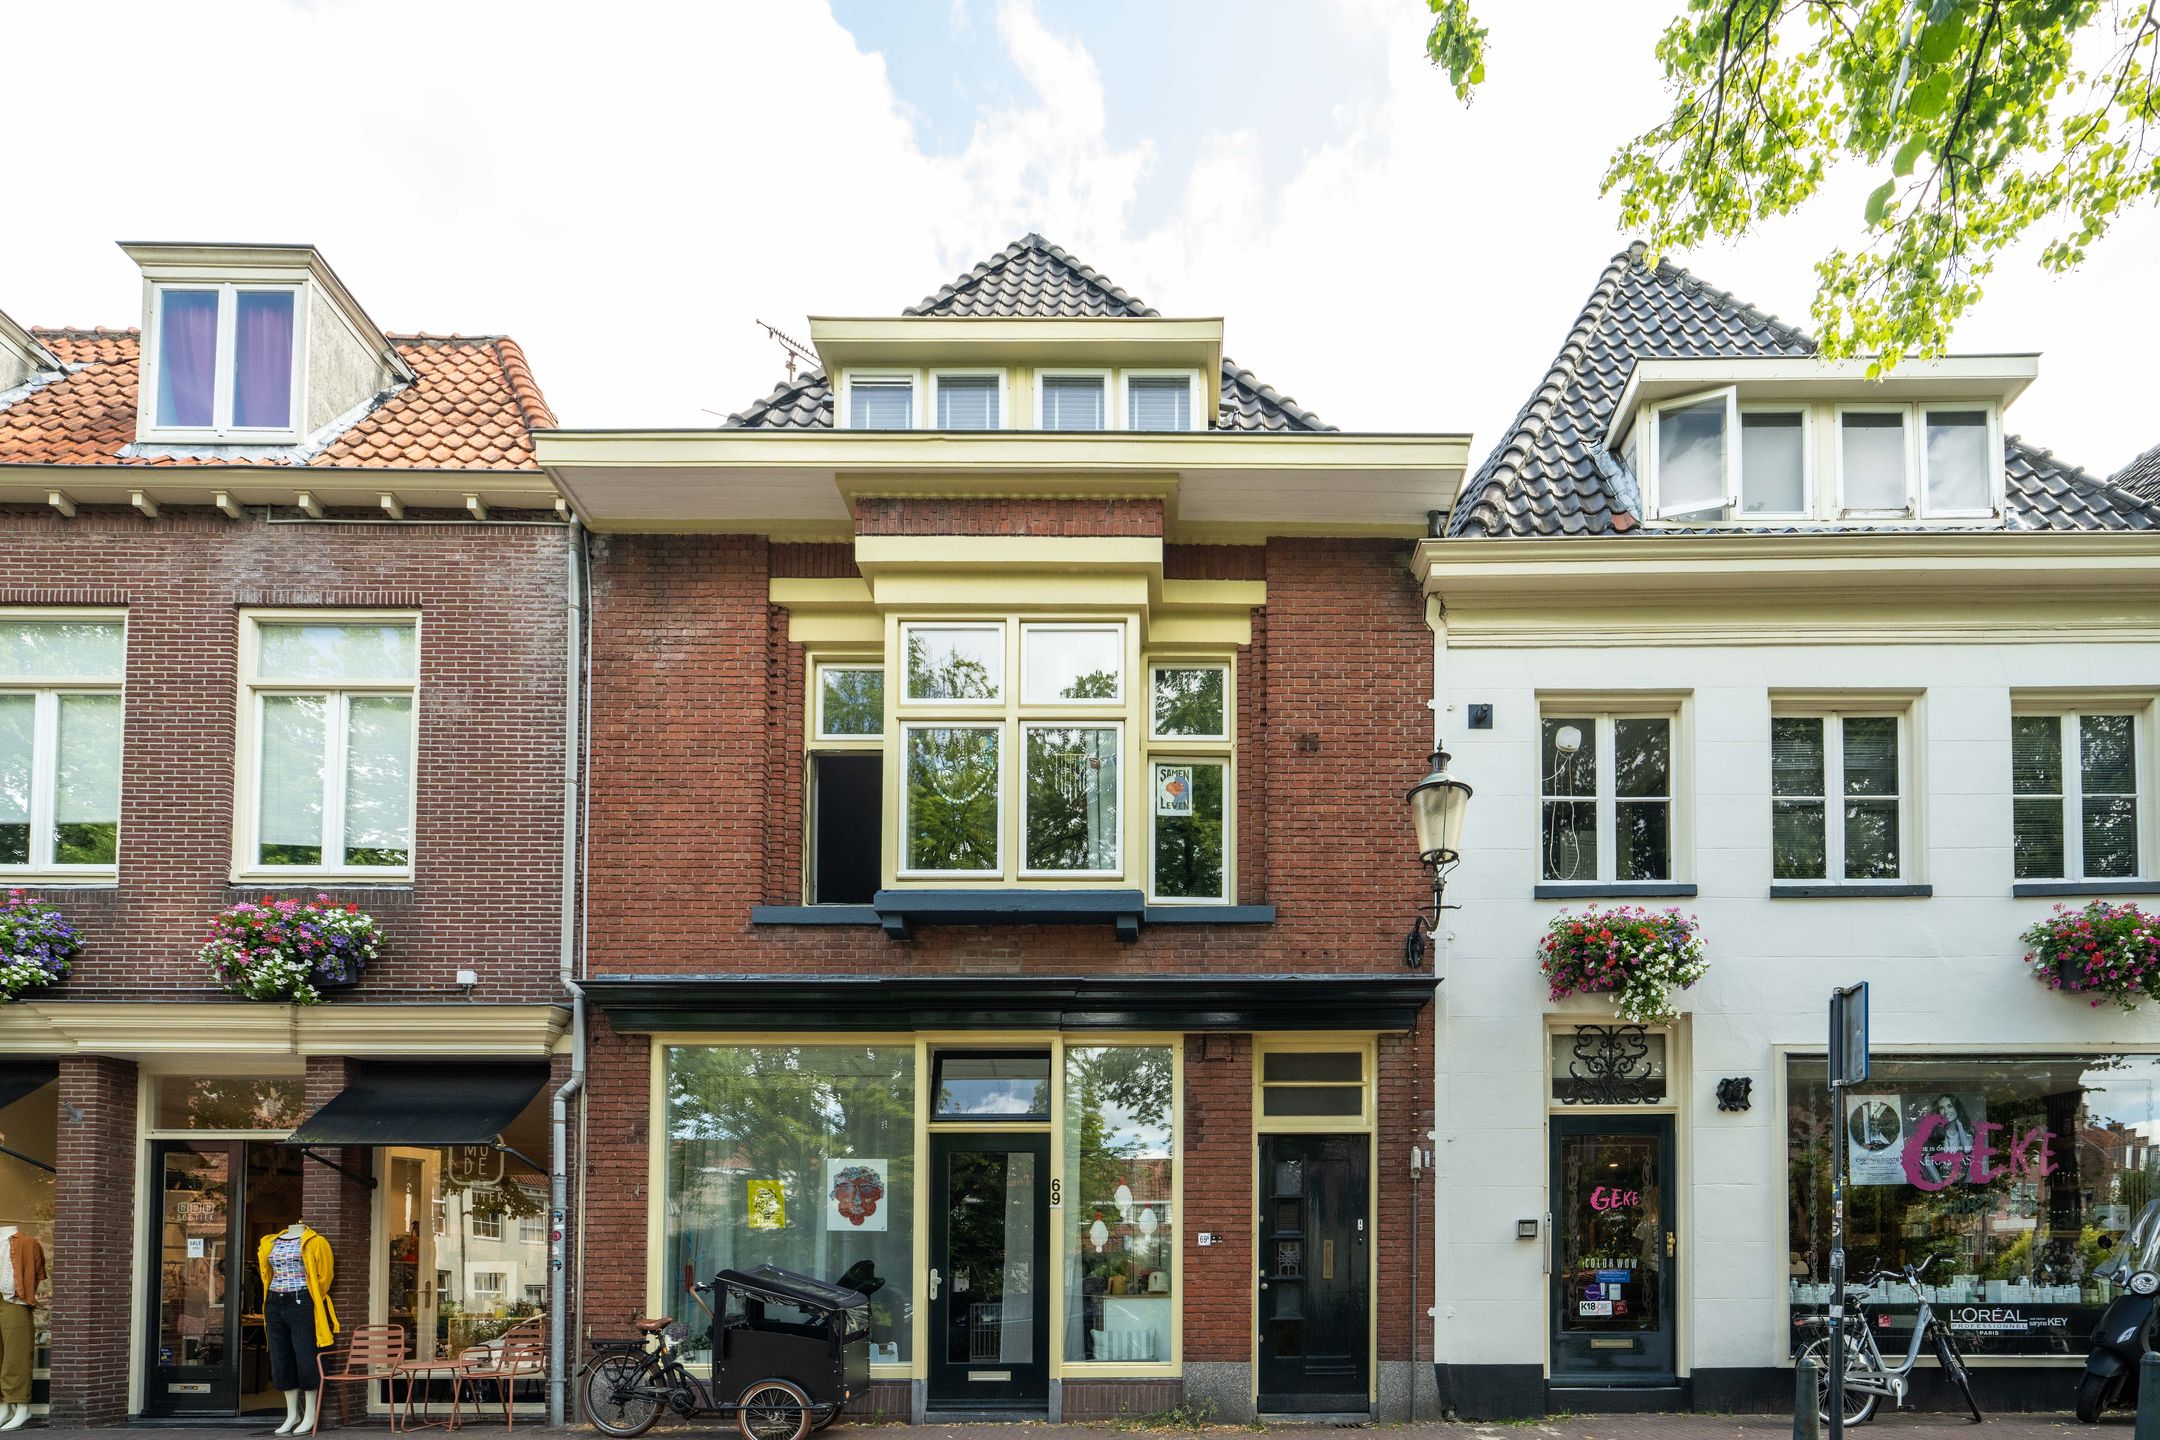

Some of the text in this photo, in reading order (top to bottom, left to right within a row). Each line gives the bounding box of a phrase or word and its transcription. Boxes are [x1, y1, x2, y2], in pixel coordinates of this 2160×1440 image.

[1160, 769, 1190, 782] SAMEN
[1160, 795, 1190, 811] LEVEN
[1902, 1112, 2059, 1192] GEKE
[1051, 1178, 1061, 1206] 69
[1590, 1186, 1639, 1211] GEKE
[1585, 1257, 1638, 1269] COLOR WOW
[1580, 1302, 1596, 1311] K18
[1950, 1307, 2028, 1322] L'ORÉAL
[2047, 1317, 2069, 1326] KEY
